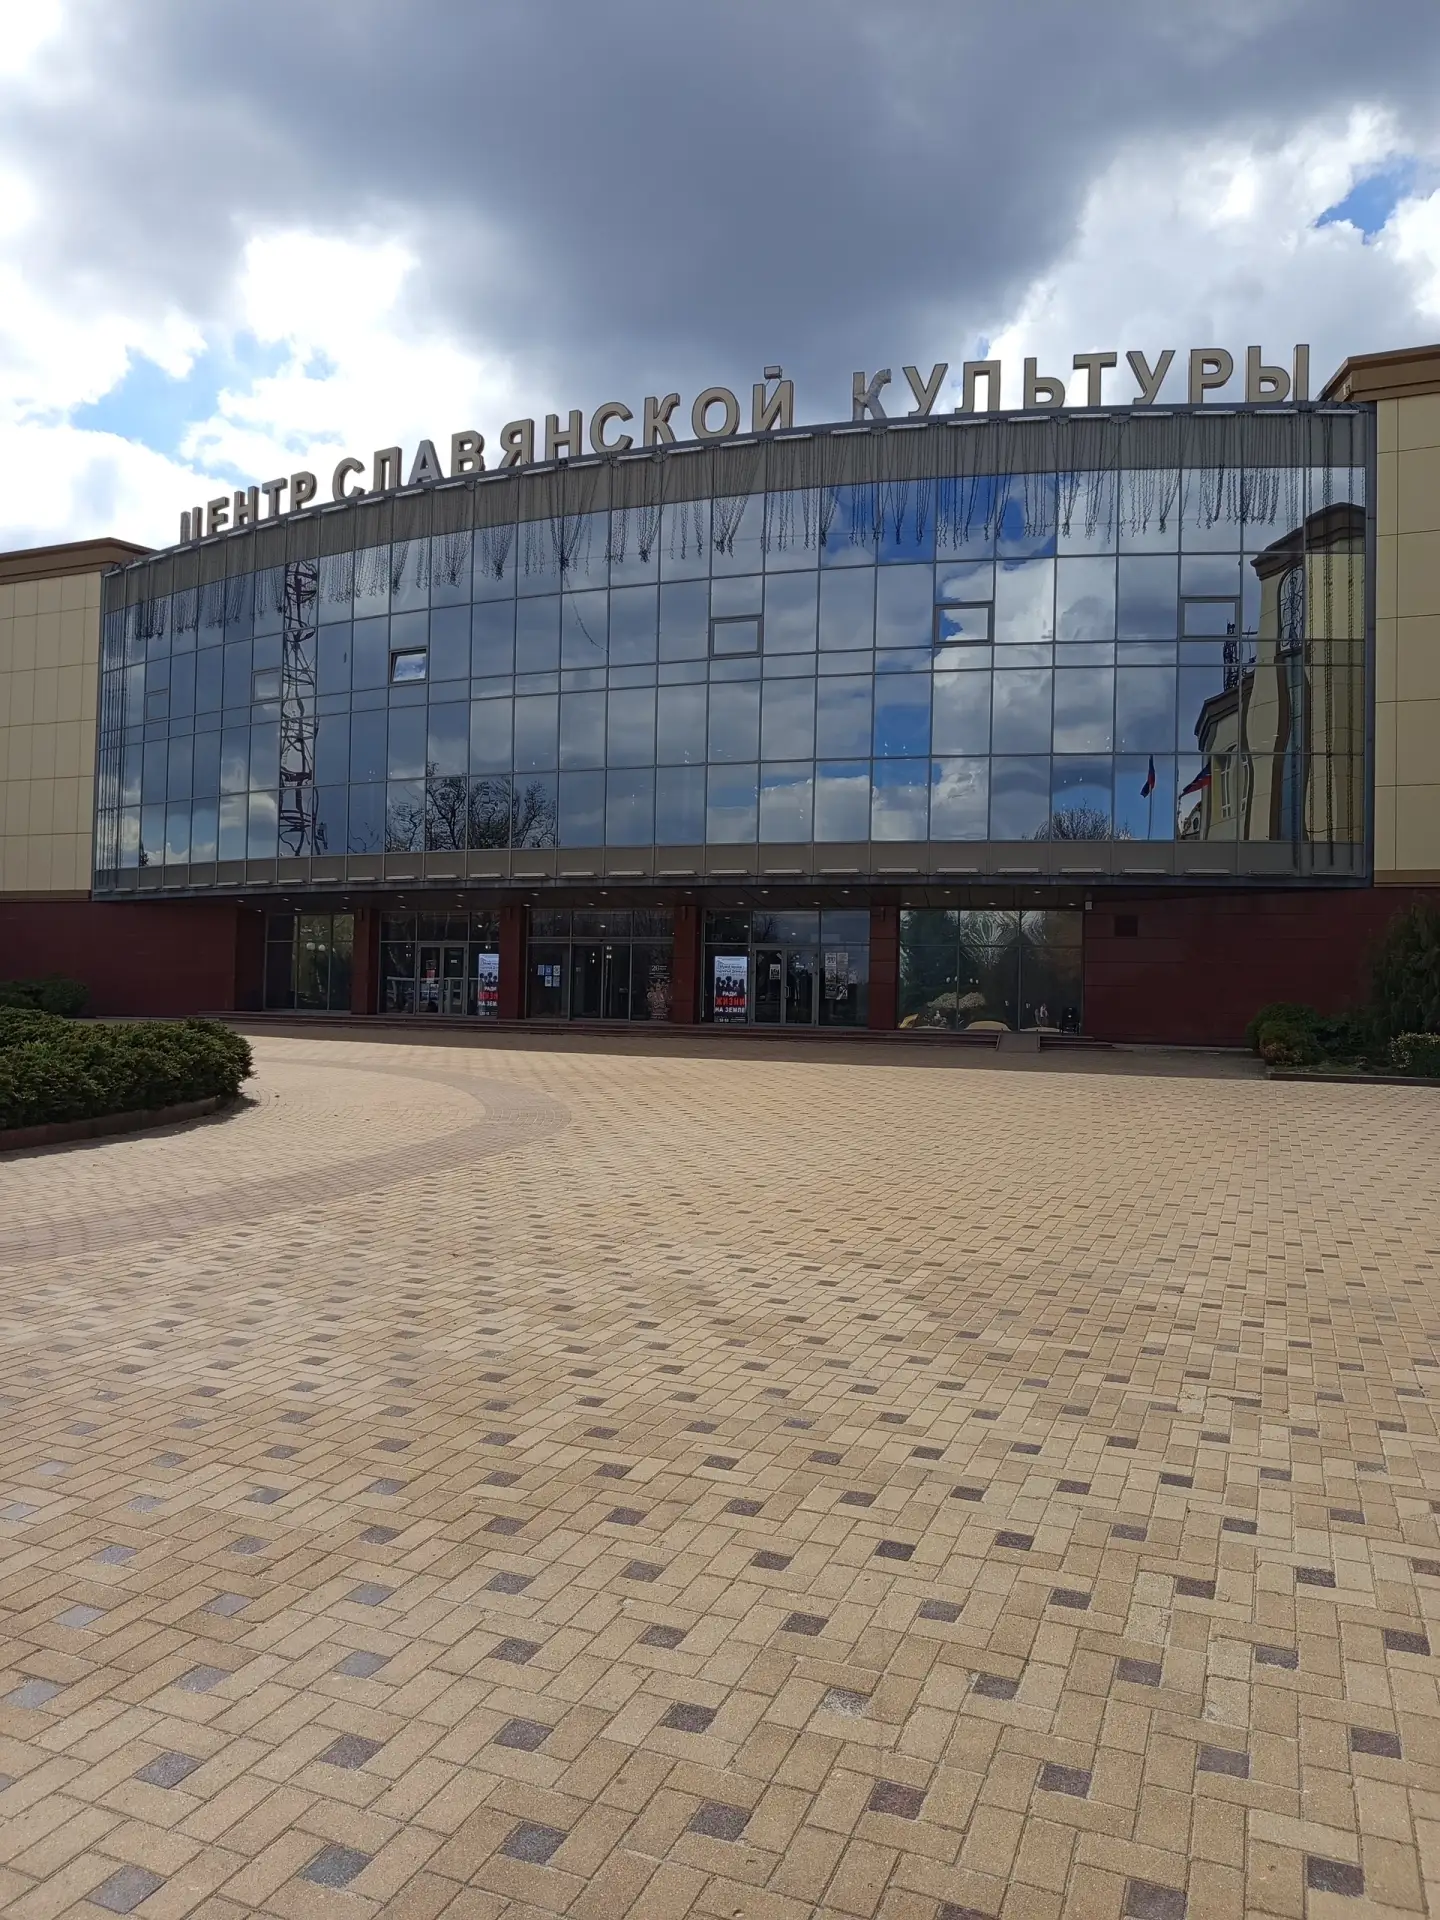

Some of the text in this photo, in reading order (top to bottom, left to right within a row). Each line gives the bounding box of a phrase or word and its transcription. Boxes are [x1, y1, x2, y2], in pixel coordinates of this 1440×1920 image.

[332, 365, 794, 499] СЛАВЯНСКОЙ
[852, 344, 1310, 421] КУЛЬТУРЫ
[716, 997, 745, 1006] ЖИЗНИ
